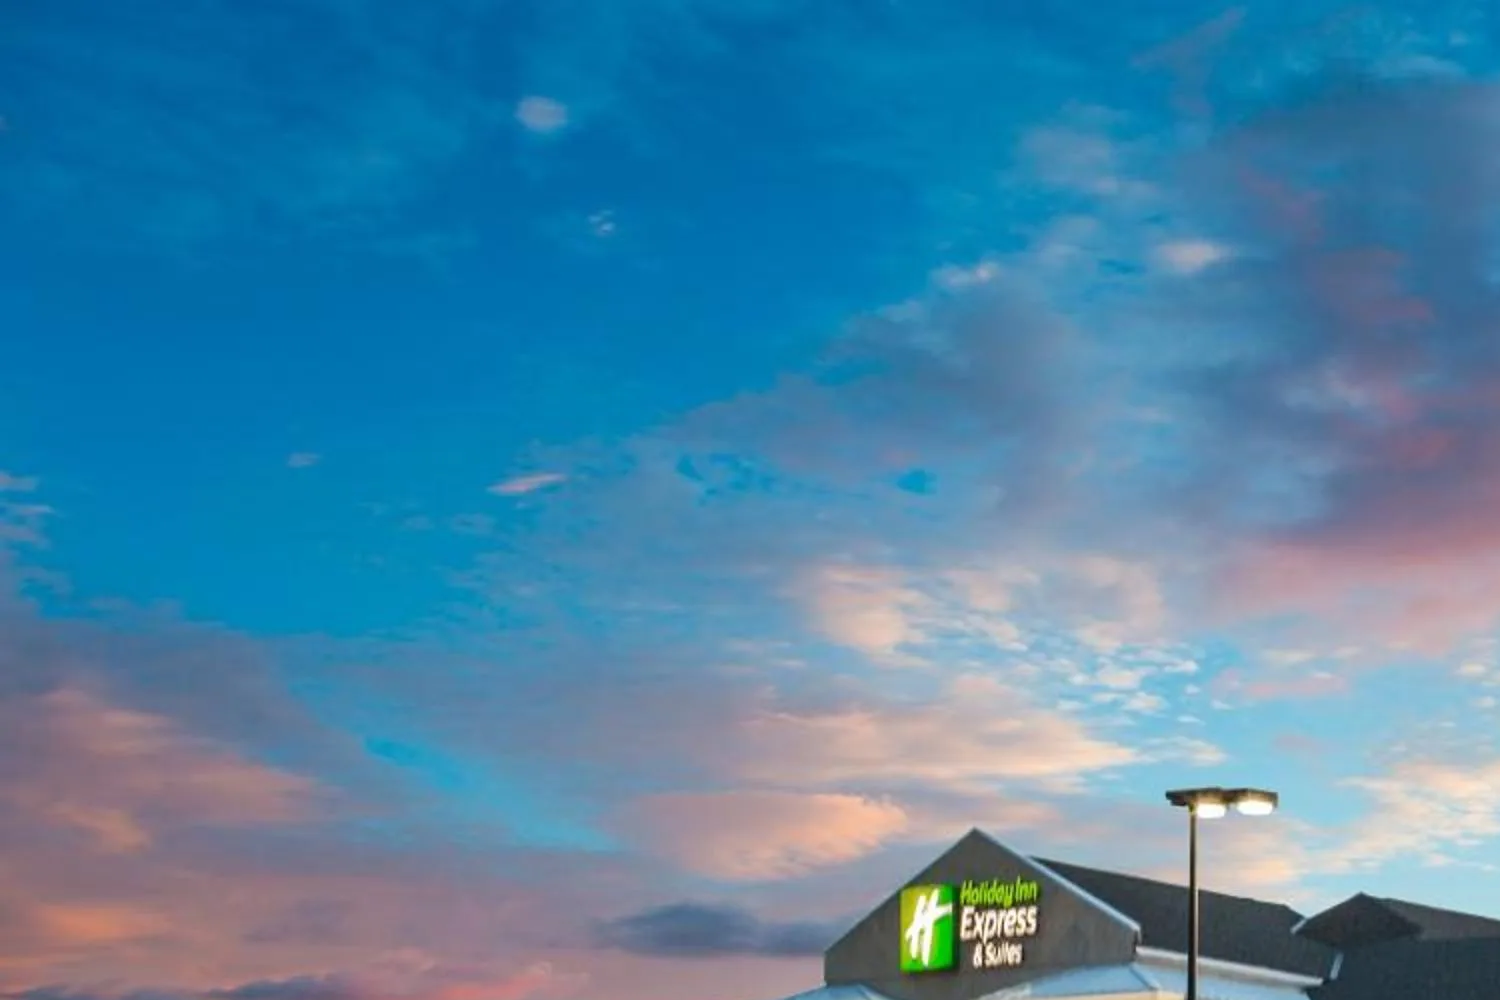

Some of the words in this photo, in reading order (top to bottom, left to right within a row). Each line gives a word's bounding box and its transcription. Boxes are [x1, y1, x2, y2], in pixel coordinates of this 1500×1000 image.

[960, 879, 1013, 907] Holiday
[1015, 876, 1038, 901] Inn
[960, 906, 1038, 944] Express
[973, 947, 983, 969] &
[984, 942, 1023, 967] Suites
